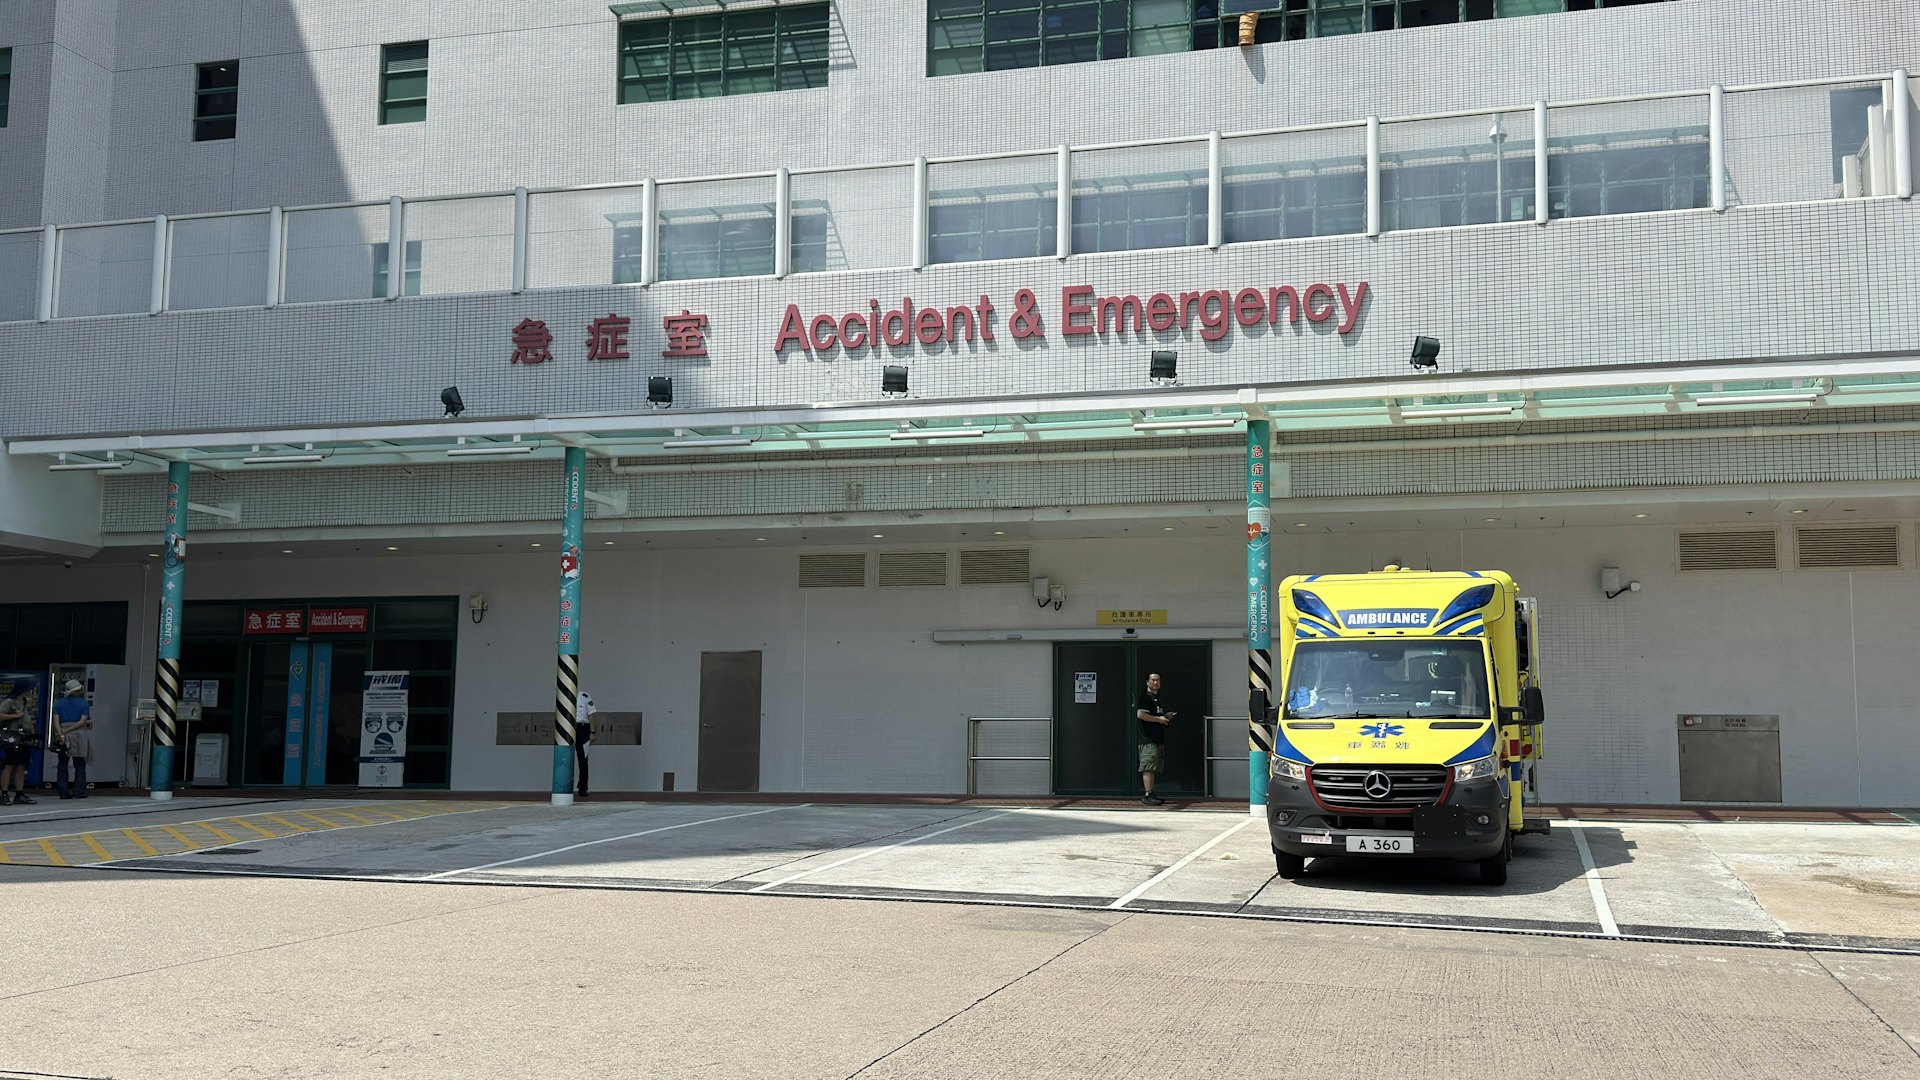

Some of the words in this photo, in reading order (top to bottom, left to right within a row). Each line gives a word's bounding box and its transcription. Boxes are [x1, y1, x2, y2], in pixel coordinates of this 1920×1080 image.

[774, 296, 994, 352] Accident
[1009, 287, 1043, 338] &
[1061, 282, 1368, 340] Emergency
[511, 310, 708, 364] 急症室
[571, 466, 579, 503] ACCIDENT
[1251, 445, 1264, 493] 急症室
[248, 612, 301, 629] 急症室
[311, 613, 333, 626] Accident
[337, 612, 365, 628] Emergency
[559, 600, 572, 644] 急症室
[1260, 584, 1268, 625] ACCIDENT
[1348, 612, 1427, 624] AMBULANCE
[1358, 840, 1367, 850] A
[1374, 840, 1401, 851] 360
